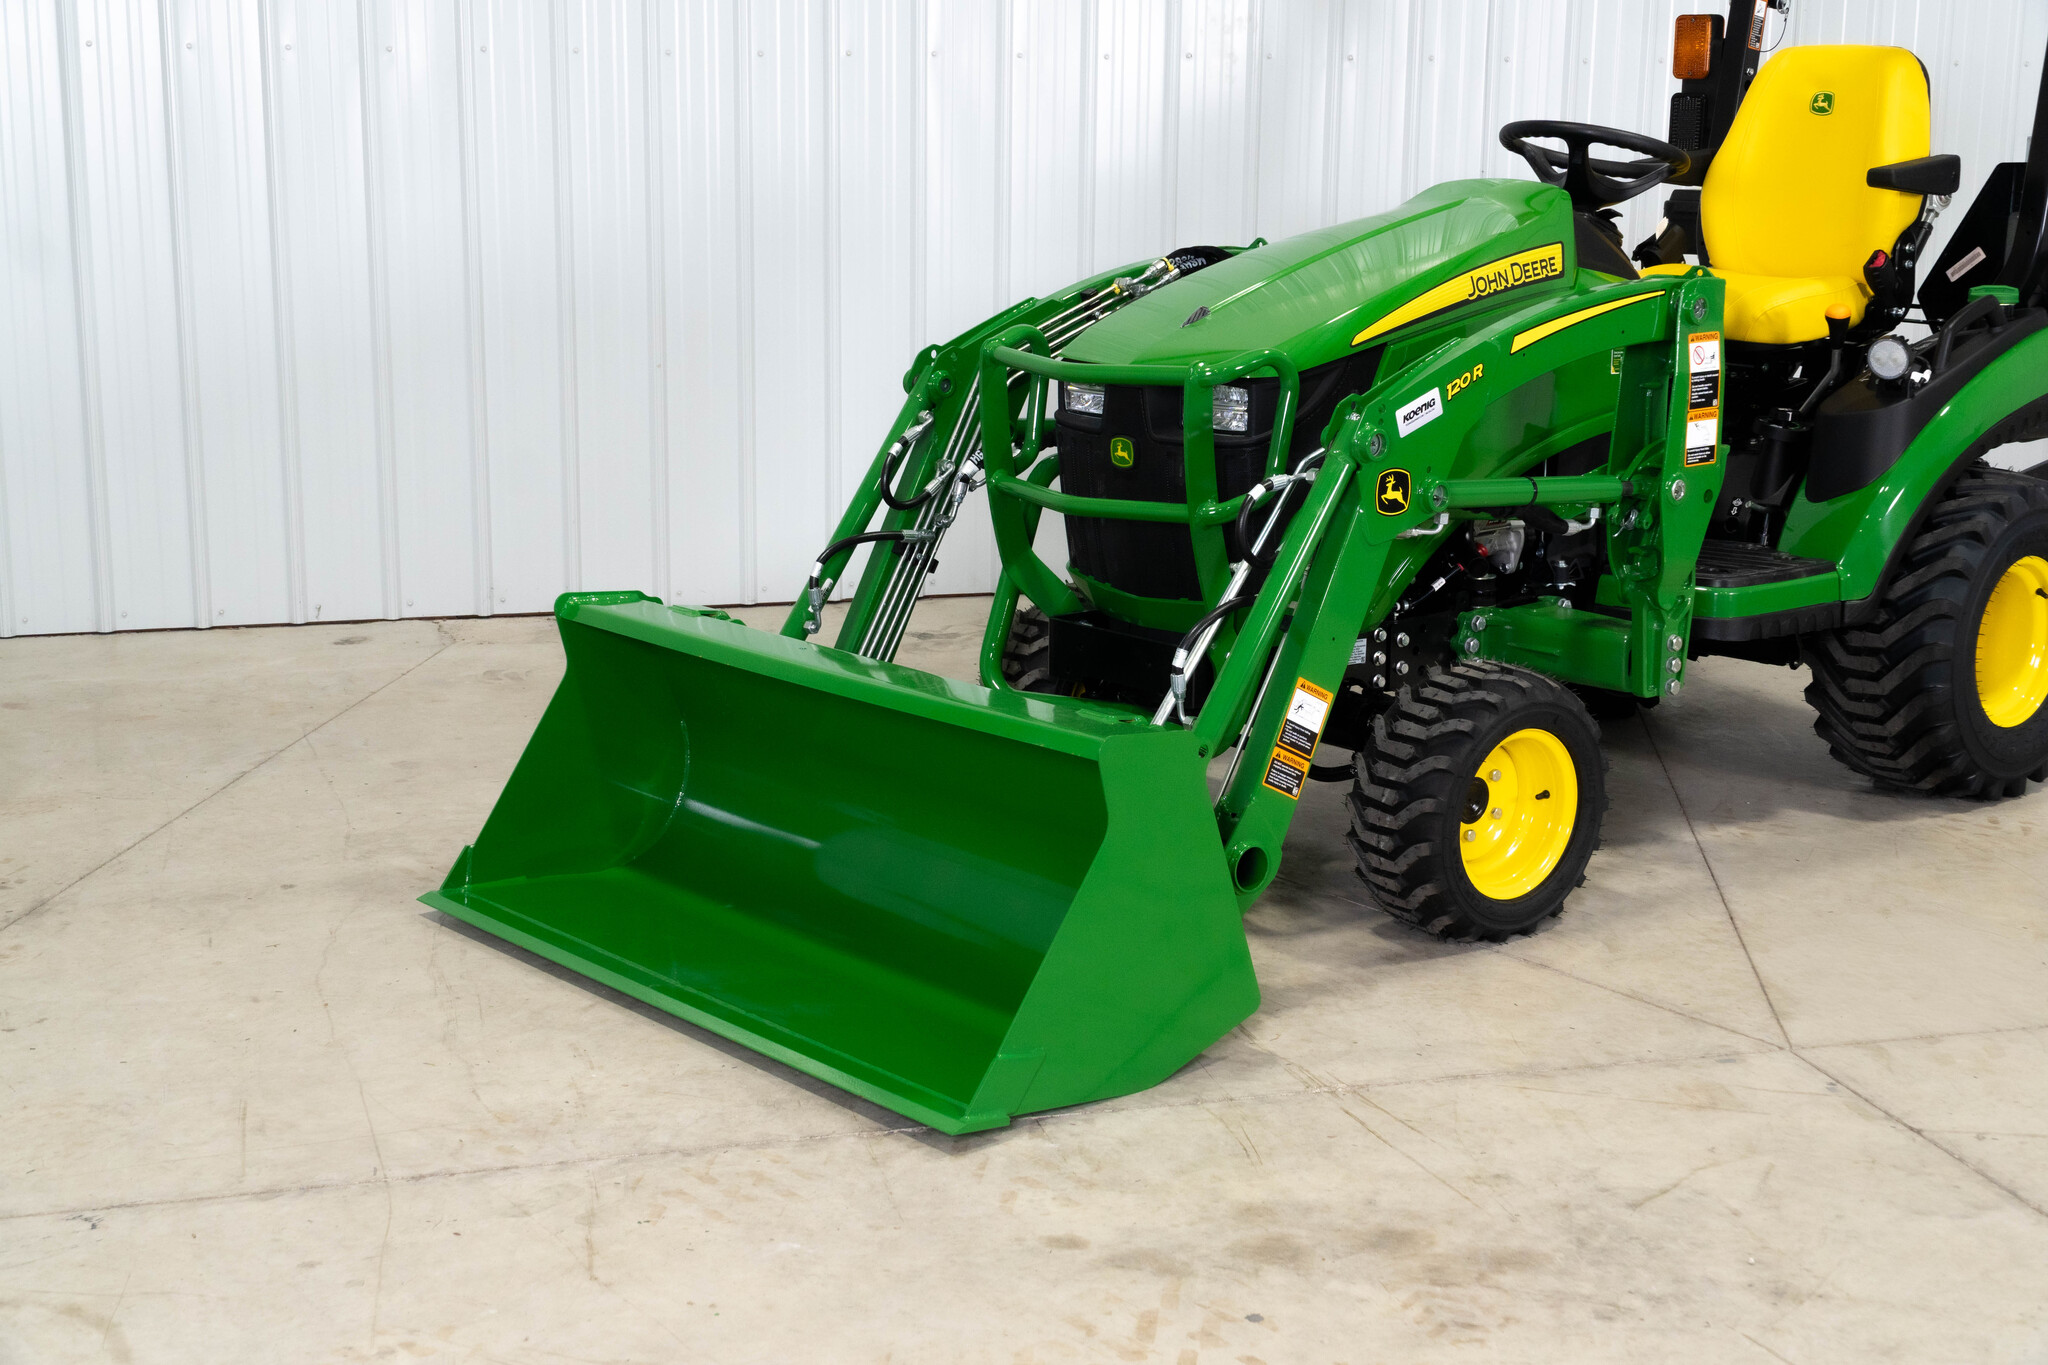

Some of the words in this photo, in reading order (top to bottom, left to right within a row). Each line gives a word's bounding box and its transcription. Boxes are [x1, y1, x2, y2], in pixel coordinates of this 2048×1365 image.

[1468, 269, 1509, 298] JOHN
[1510, 256, 1558, 283] DEERE
[1695, 332, 1718, 341] WARNING
[1446, 372, 1471, 402] 120
[1472, 363, 1484, 383] R
[1693, 410, 1717, 420] WARNING
[1306, 684, 1329, 701] WARNING
[1282, 754, 1305, 770] WARNING
